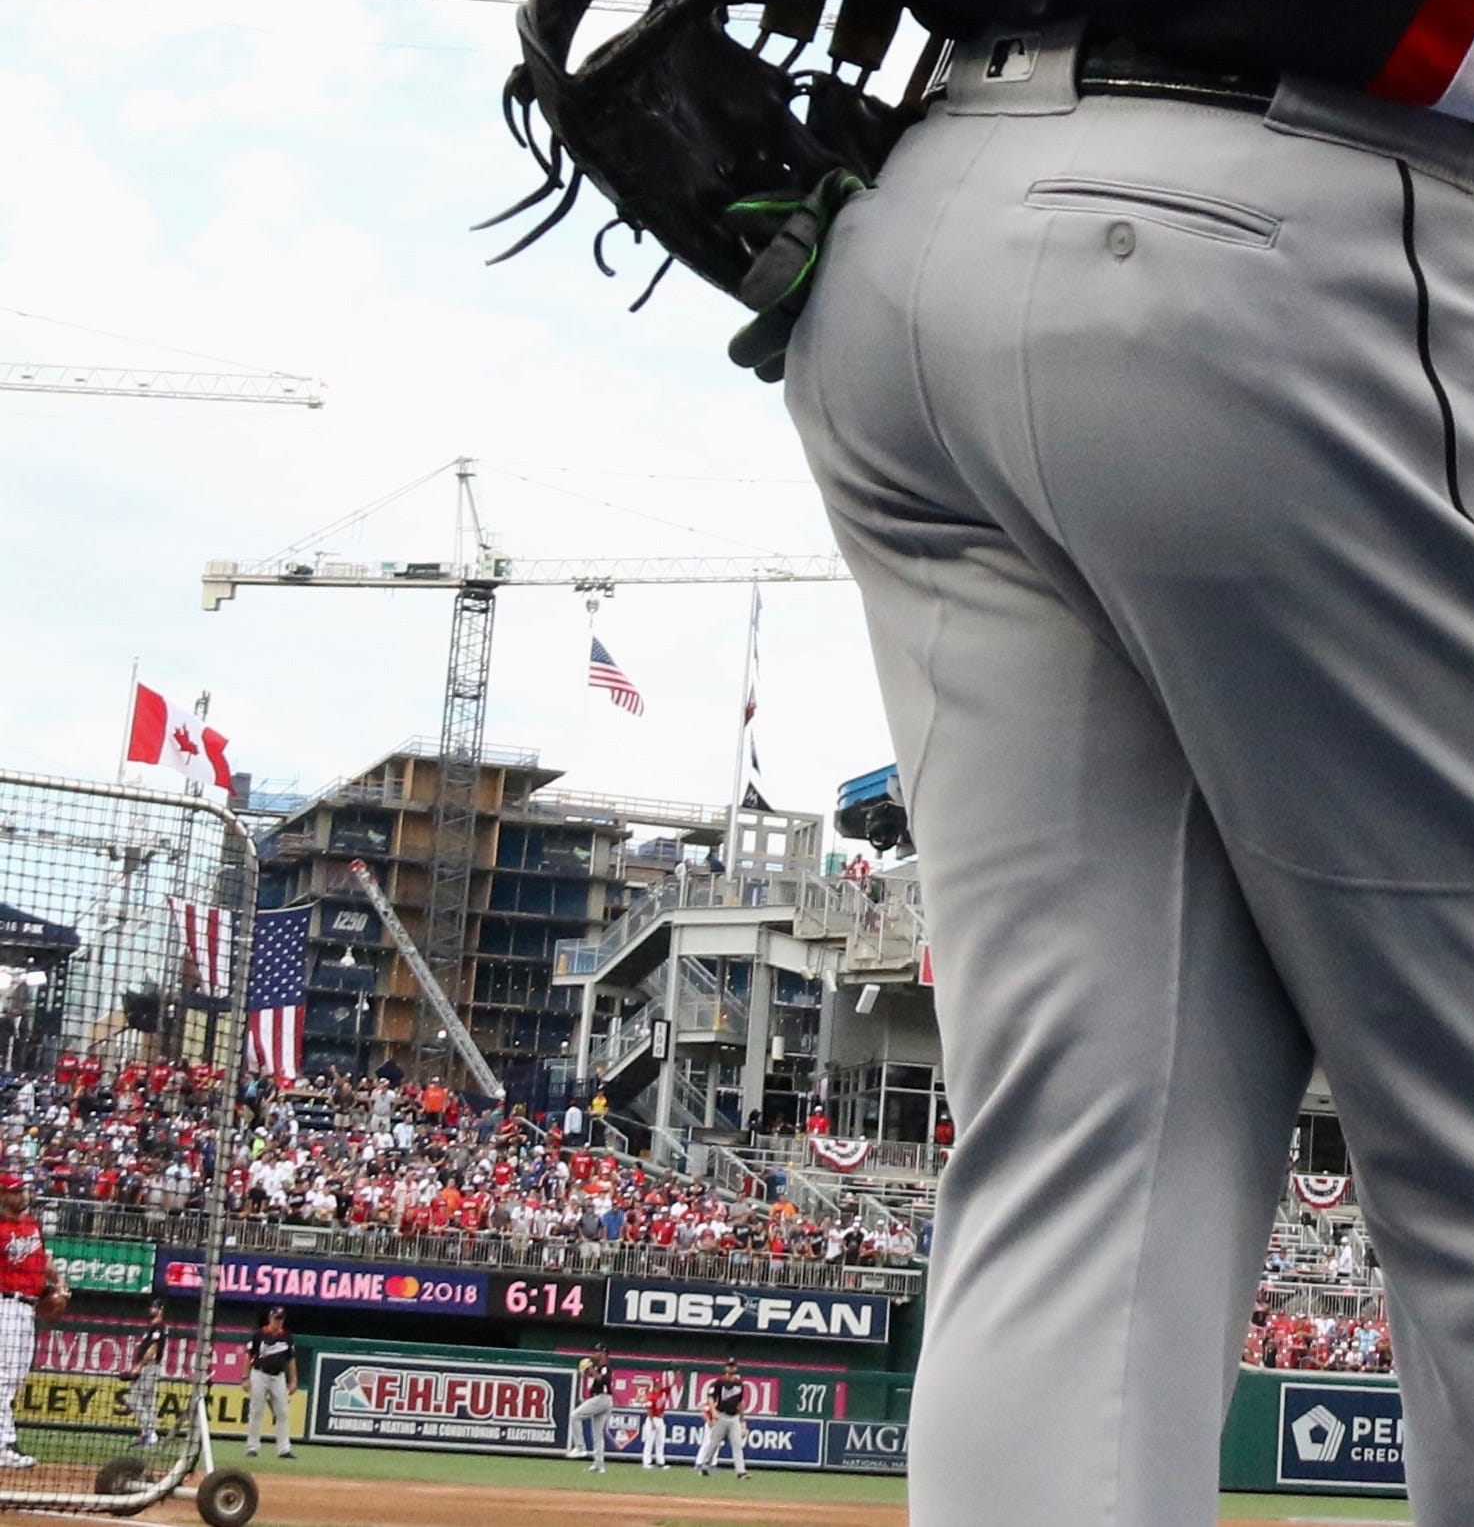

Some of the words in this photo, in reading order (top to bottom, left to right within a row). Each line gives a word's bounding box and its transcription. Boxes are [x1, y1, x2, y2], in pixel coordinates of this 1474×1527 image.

[332, 911, 369, 932] 1250
[256, 1264, 316, 1297] STAR
[321, 1268, 385, 1303] GAME
[420, 1281, 478, 1306] 2018
[504, 1280, 584, 1317] 6:14
[624, 1289, 745, 1328] 106.7
[757, 1298, 873, 1337] FAN
[798, 1383, 827, 1414] 377
